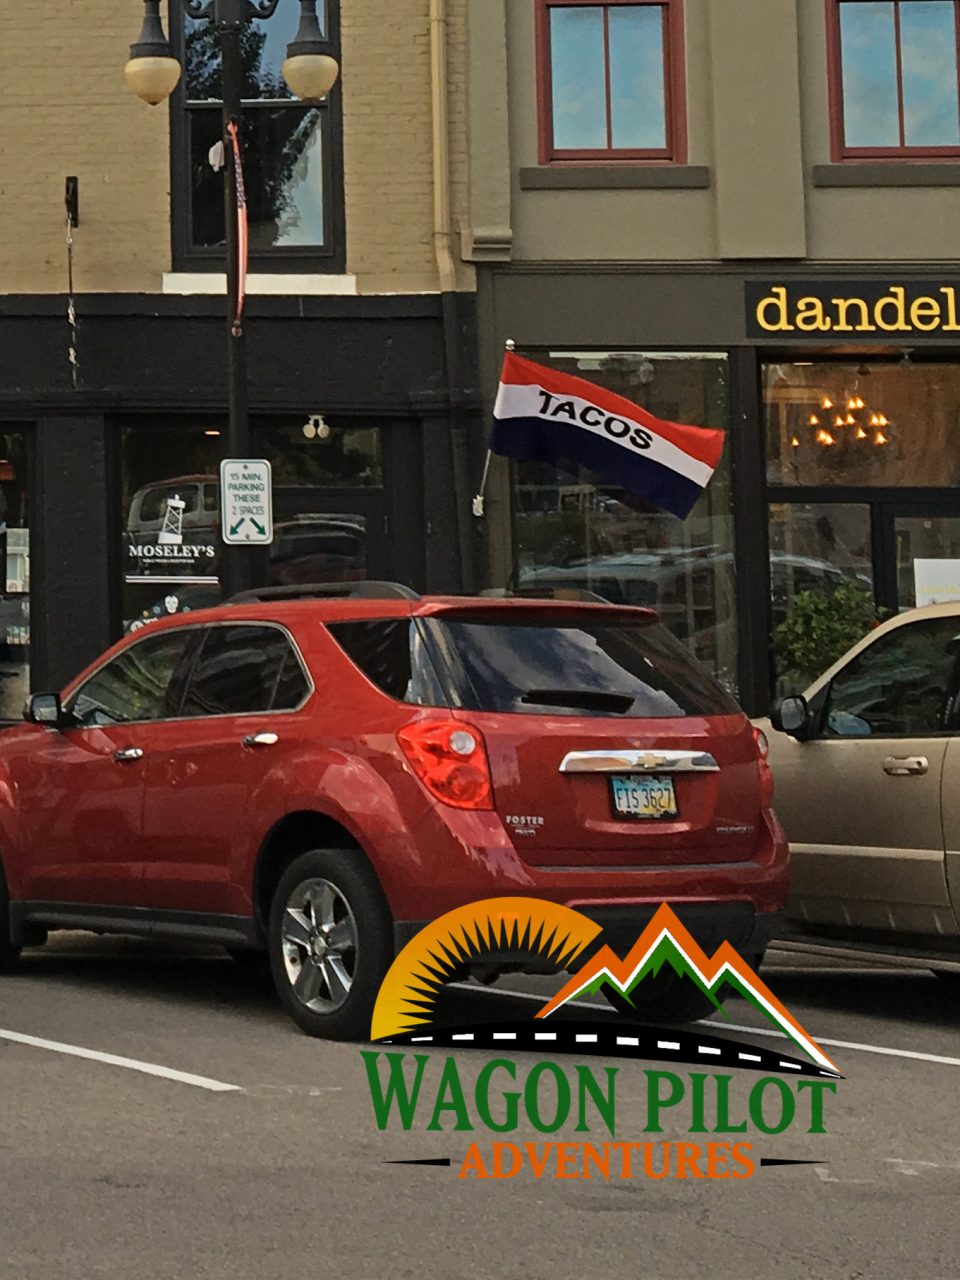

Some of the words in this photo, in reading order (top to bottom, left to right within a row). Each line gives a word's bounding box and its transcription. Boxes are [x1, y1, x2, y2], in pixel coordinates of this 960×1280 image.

[756, 286, 960, 331] dandel
[539, 390, 654, 450] TACOS
[228, 483, 265, 491] PARKING
[232, 494, 261, 502] THESE
[232, 506, 237, 515] 2
[239, 506, 265, 515] SPACES
[128, 545, 215, 557] MOSELEY'S
[616, 788, 639, 808] FIS
[642, 788, 672, 808] 3627
[506, 816, 544, 825] FOSTER
